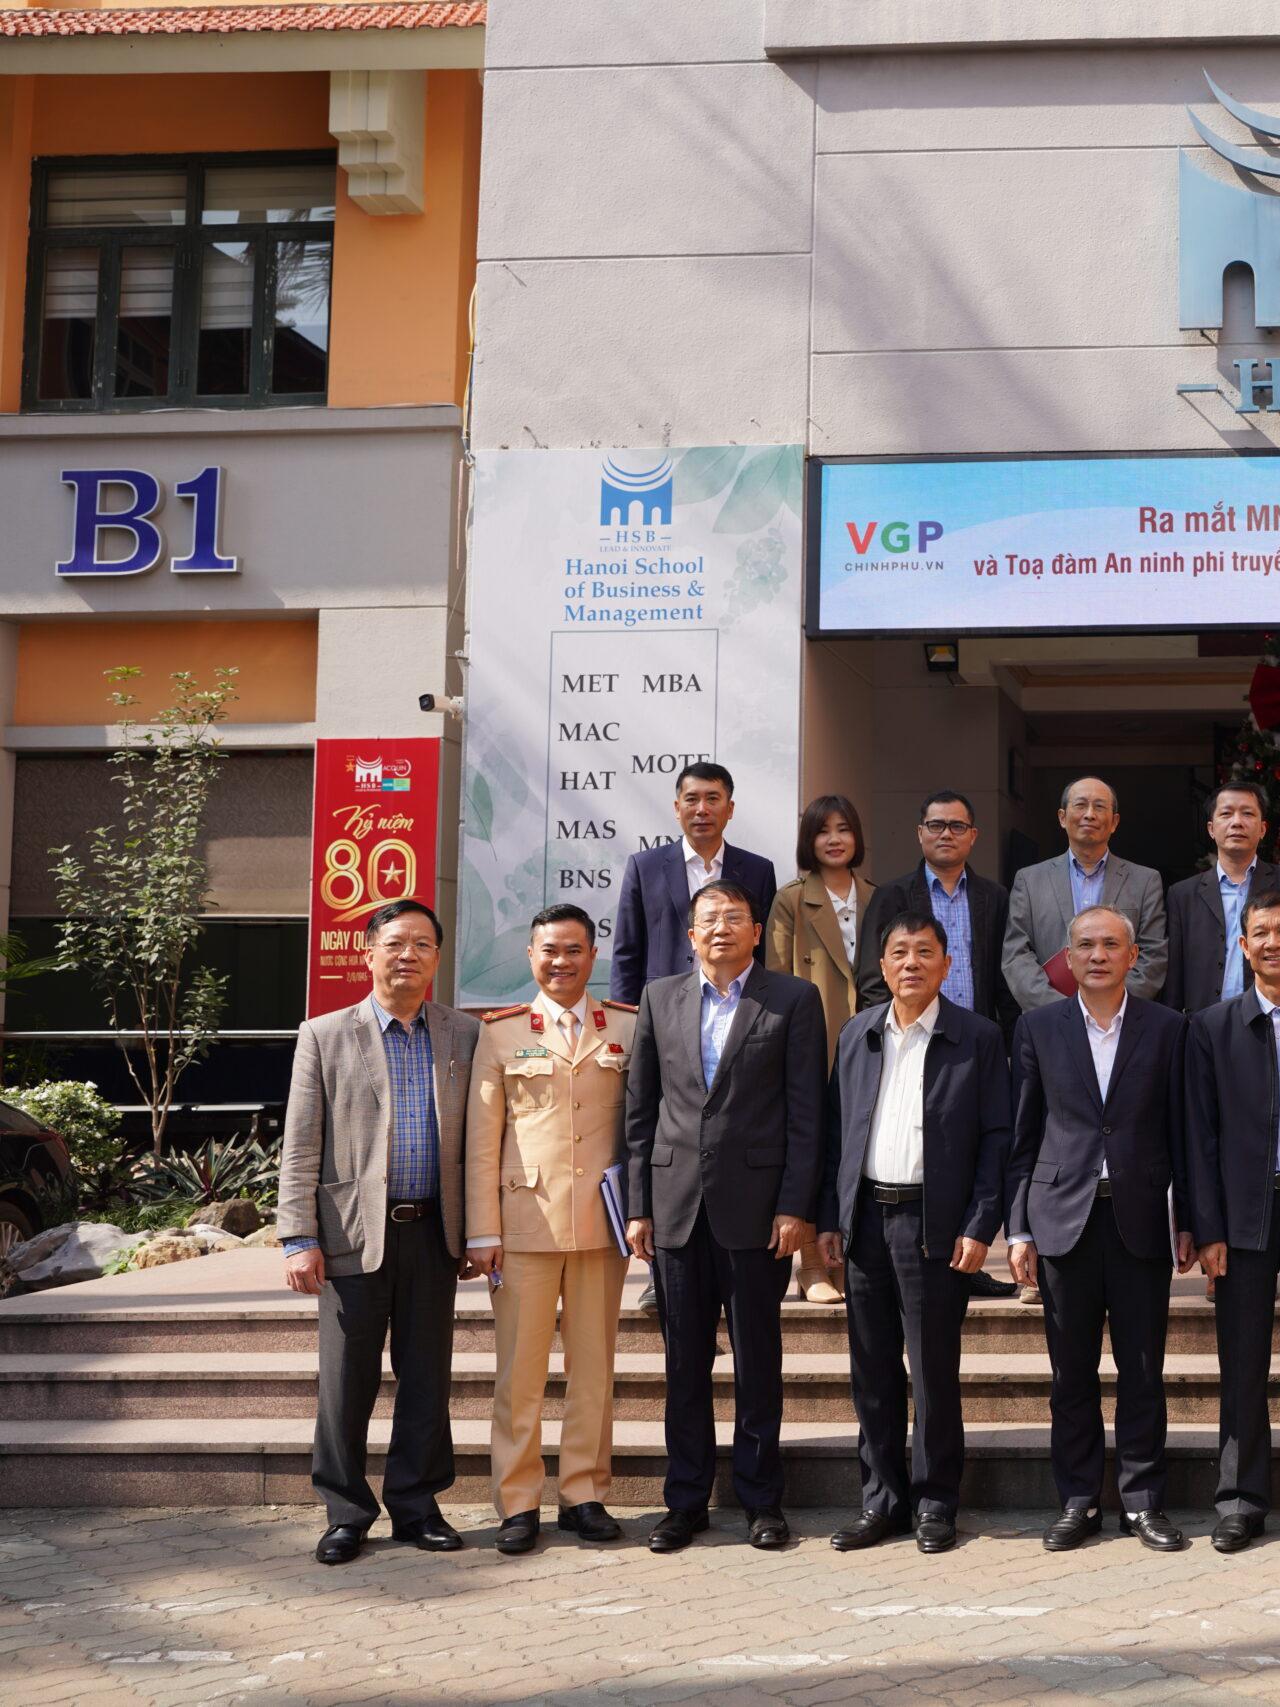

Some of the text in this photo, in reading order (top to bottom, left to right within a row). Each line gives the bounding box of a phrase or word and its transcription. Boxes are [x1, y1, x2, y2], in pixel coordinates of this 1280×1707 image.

[55, 466, 241, 577] B1
[1139, 507, 1174, 533] Ra
[1185, 501, 1236, 533] mắt
[616, 530, 656, 543] HSB
[846, 520, 944, 555] VGP
[566, 556, 704, 576] Hanoi School
[845, 561, 944, 572] CHINHPHU.VN
[974, 555, 998, 576] và
[1005, 555, 1043, 580] Toạ
[1052, 553, 1097, 576] đàm
[1105, 552, 1132, 574] An
[1140, 552, 1184, 573] ninh
[1193, 551, 1224, 577] phi
[564, 580, 705, 599] of Business &
[564, 604, 703, 626] Management
[562, 673, 703, 693] MET MBA
[558, 722, 620, 742] MAC
[559, 771, 616, 791] HAT
[377, 813, 414, 834] niệm
[556, 819, 616, 840] MAS
[320, 838, 417, 910] 80
[559, 868, 612, 889] BNS
[320, 929, 368, 952] NGÀY QU
